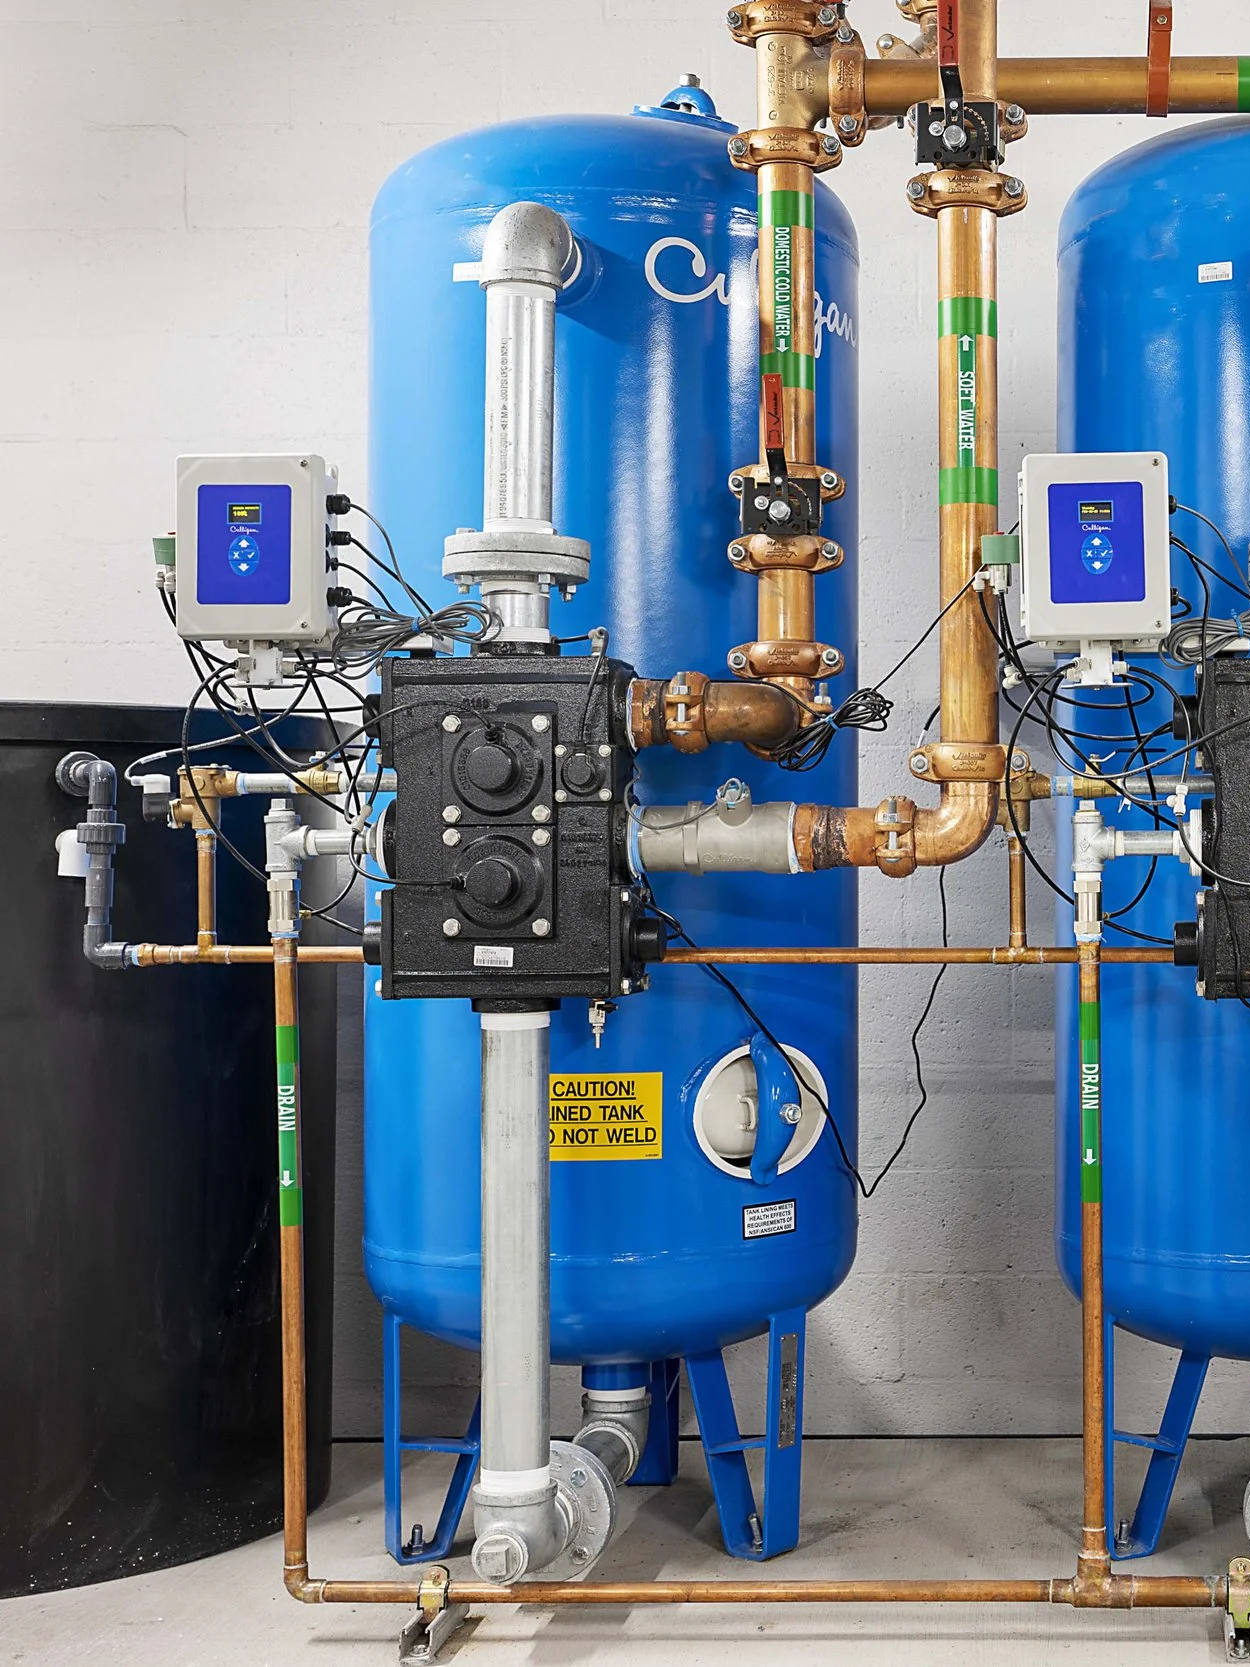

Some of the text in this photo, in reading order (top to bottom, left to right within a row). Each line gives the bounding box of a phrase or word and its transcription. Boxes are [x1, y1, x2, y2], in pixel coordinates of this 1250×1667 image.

[775, 227, 790, 336] DOMESTIC COLD WATER
[959, 371, 975, 450] SOFT WATER
[552, 1080, 635, 1097] CAUTION!
[1082, 1063, 1099, 1109] DRAIN
[278, 1085, 296, 1131] DRAIN
[549, 1104, 645, 1121] INED TANK
[563, 1128, 599, 1144] NOT
[606, 1127, 657, 1144] WELD
[760, 1205, 777, 1213] LINING
[770, 1210, 791, 1218] EFFECTS
[747, 1218, 786, 1228] REQUIREMENTS
